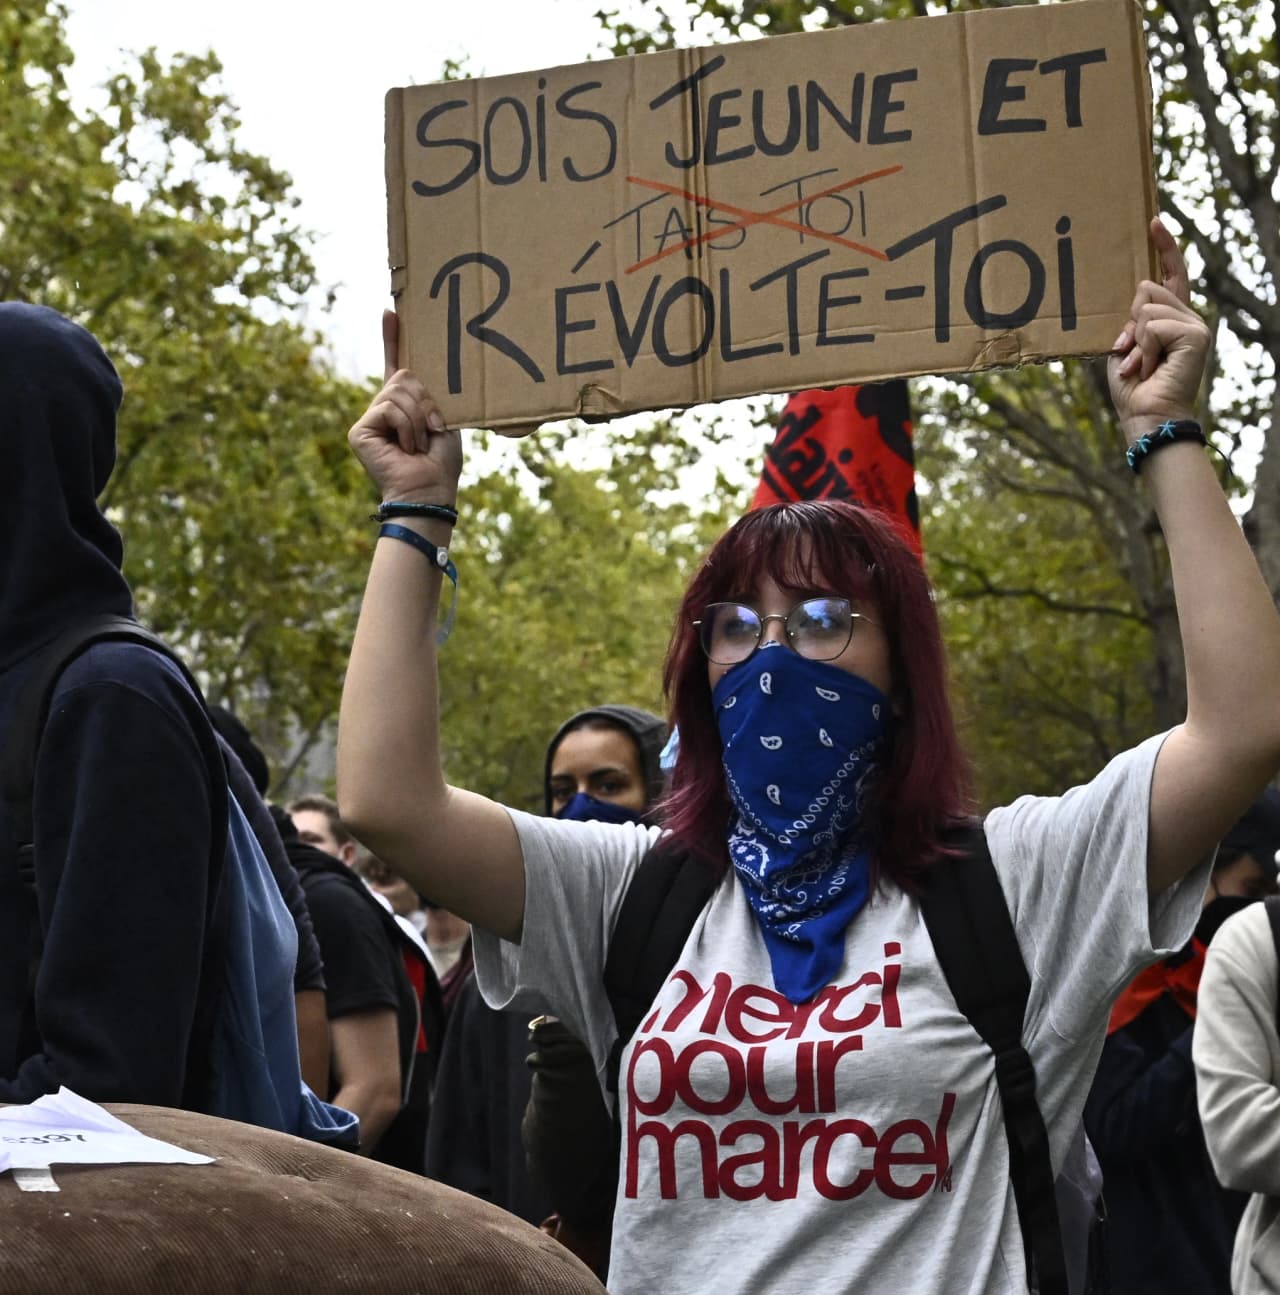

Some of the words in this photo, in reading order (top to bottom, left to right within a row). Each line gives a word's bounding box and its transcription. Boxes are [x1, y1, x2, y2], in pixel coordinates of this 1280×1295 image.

[412, 78, 617, 197] SOIS
[649, 56, 918, 170] JEUNE
[976, 47, 1107, 136] ET
[760, 168, 867, 245] TOI
[428, 194, 1078, 394] RÉVOLTE-TOI
[627, 1034, 863, 1119] pour
[624, 1092, 956, 1202] marcel
